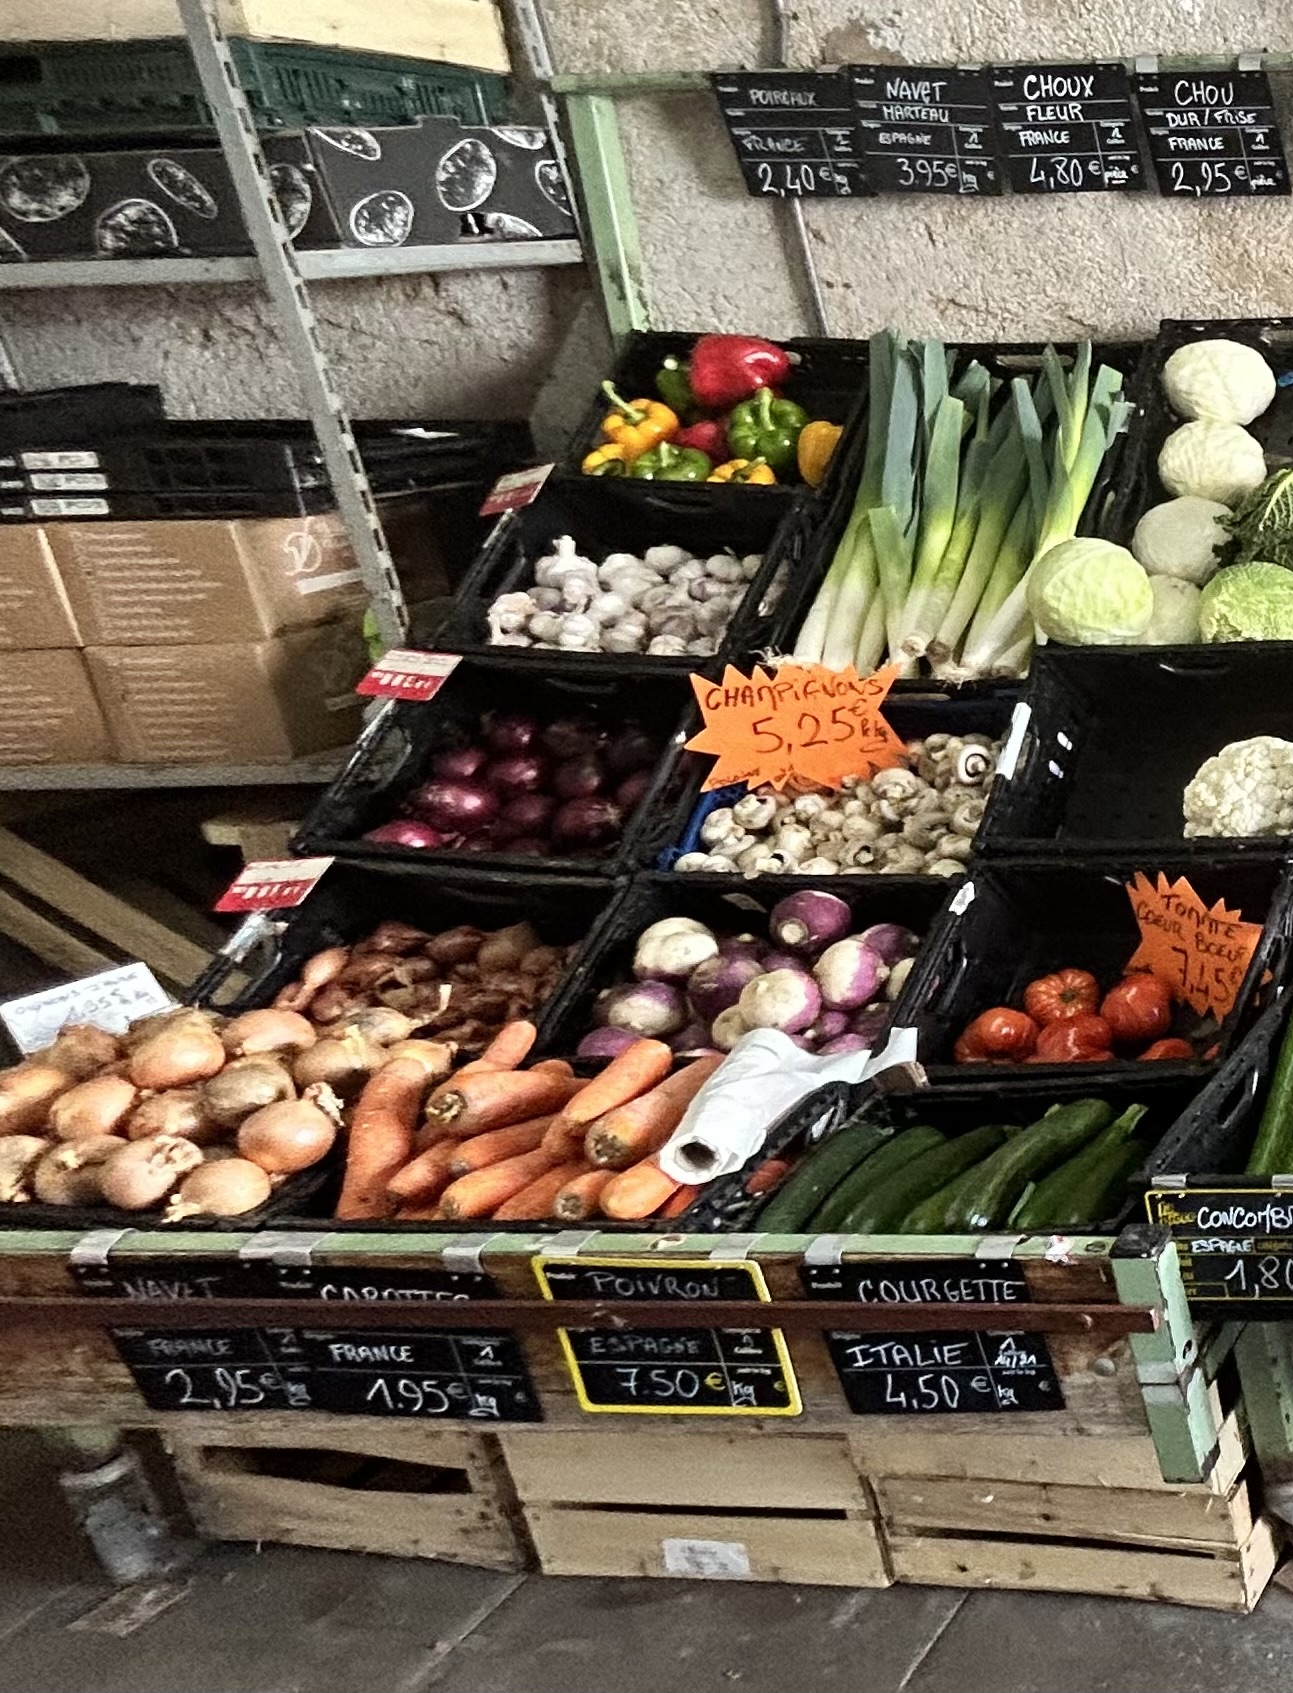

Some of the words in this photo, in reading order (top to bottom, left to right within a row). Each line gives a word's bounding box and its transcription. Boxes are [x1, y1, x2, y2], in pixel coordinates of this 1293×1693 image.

[750, 89, 818, 107] POIREAUX
[886, 77, 948, 103] NAVET
[1024, 74, 1094, 100] CHOUX
[1175, 80, 1234, 105] CHOU
[882, 105, 949, 122] MARTEAU
[1026, 103, 1084, 122] FLEUR
[742, 135, 804, 152] FRANCE
[1019, 129, 1070, 147] FRANCE
[1168, 136, 1225, 151] FRANCE
[758, 163, 815, 197] 2,40
[1030, 157, 1083, 189] 4,80
[1172, 161, 1232, 197] 2,95
[752, 705, 855, 755] 5,25
[1191, 1238, 1254, 1253] ESPAGNE
[122, 1276, 223, 1300] NAVET
[584, 1271, 719, 1298] POIVRON
[858, 1279, 1026, 1303] COURGETTE
[328, 1344, 414, 1363] FRANCE
[846, 1341, 969, 1367] ITALIE
[705, 1372, 725, 1391] €
[971, 1376, 991, 1393] €
